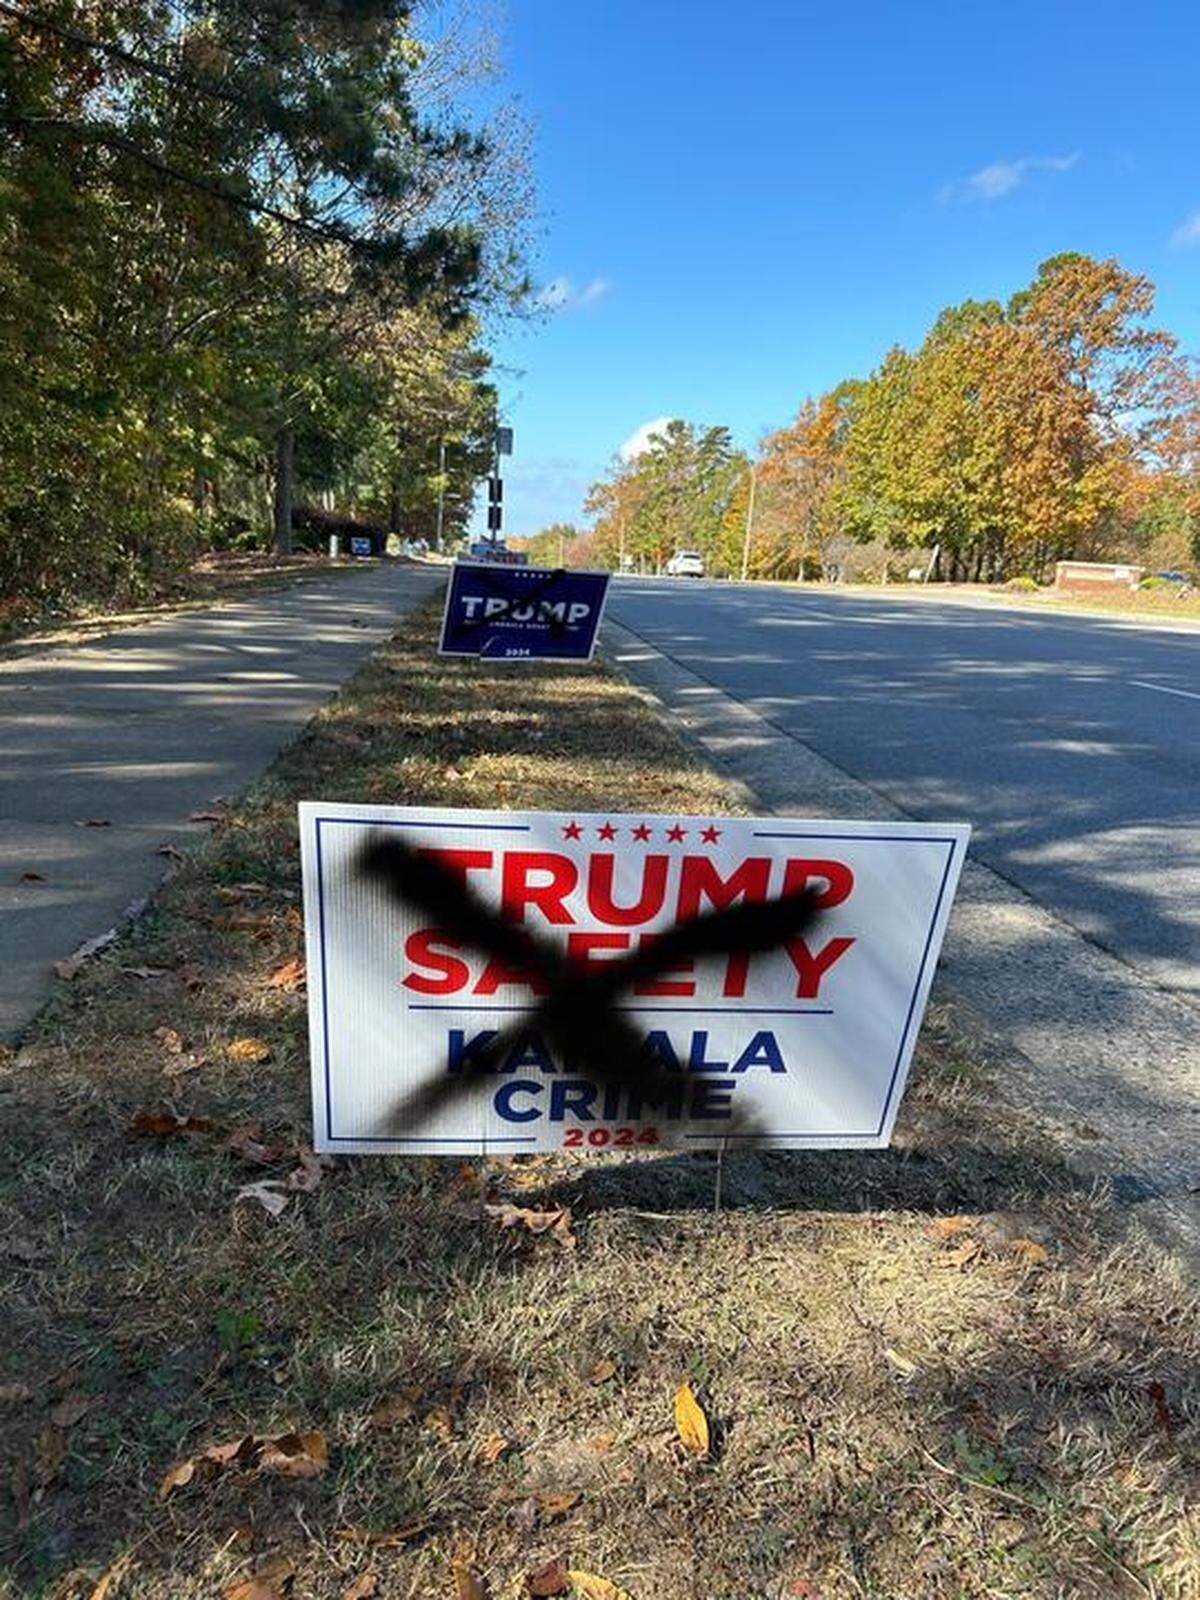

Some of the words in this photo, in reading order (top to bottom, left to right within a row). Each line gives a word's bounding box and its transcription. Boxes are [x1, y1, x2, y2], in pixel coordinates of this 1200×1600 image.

[461, 596, 590, 623] TRUMP
[416, 848, 855, 930] TRUMP
[448, 1029, 788, 1073] KAALA
[493, 1079, 736, 1123] CRIME
[563, 1127, 659, 1147] 2024
